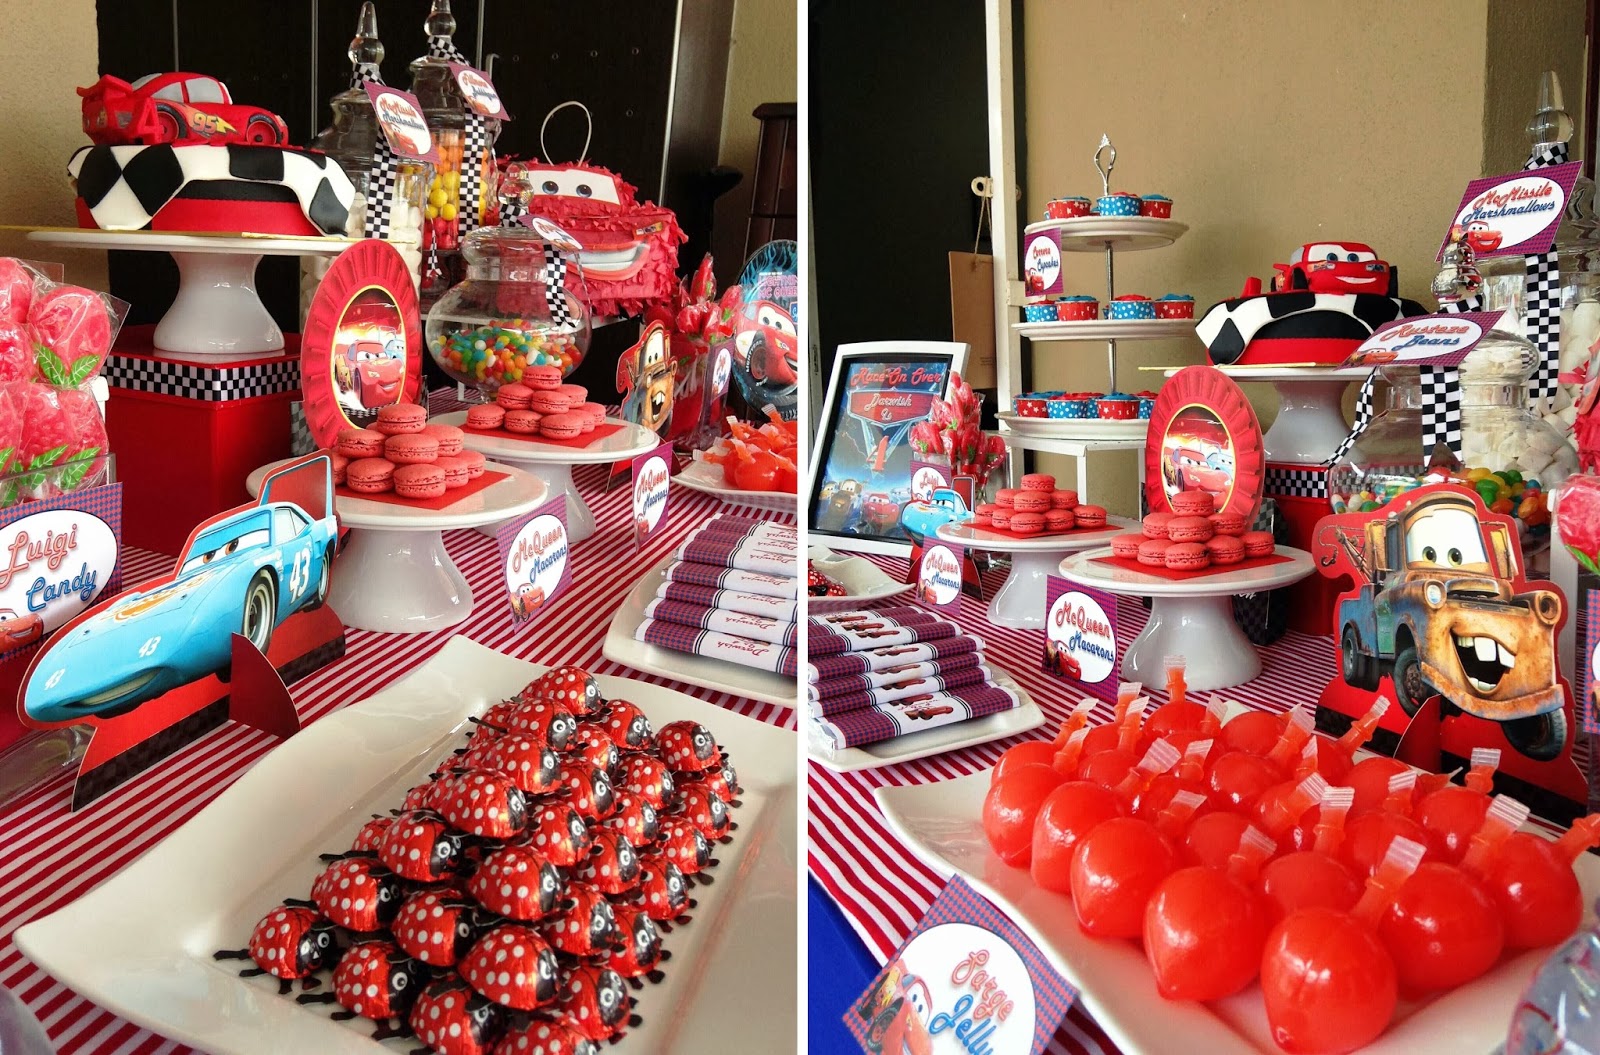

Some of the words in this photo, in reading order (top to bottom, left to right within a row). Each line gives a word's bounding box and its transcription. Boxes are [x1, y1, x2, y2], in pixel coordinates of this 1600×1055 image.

[193, 111, 217, 134] 95
[1472, 181, 1553, 212] McMissile
[1461, 199, 1556, 226] Marshmallows
[1380, 323, 1470, 342] Rusteze
[1391, 334, 1461, 351] Beans
[911, 367, 942, 386] Over
[864, 392, 912, 412] Darwish
[866, 435, 889, 472] 4
[636, 468, 667, 503] McQueen
[0, 523, 78, 590] Luigi
[512, 525, 563, 573] McQueen
[529, 543, 567, 584] Macarons
[925, 551, 959, 576] McQueen
[25, 562, 97, 613] Candy
[289, 547, 311, 604] 43
[725, 616, 777, 630] Darwish
[1055, 600, 1111, 639] McQueen
[138, 635, 162, 658] 43
[717, 640, 770, 657] Darwish
[1068, 630, 1115, 663] Macarons
[44, 668, 66, 691] 43
[951, 949, 1015, 1022] Sarge
